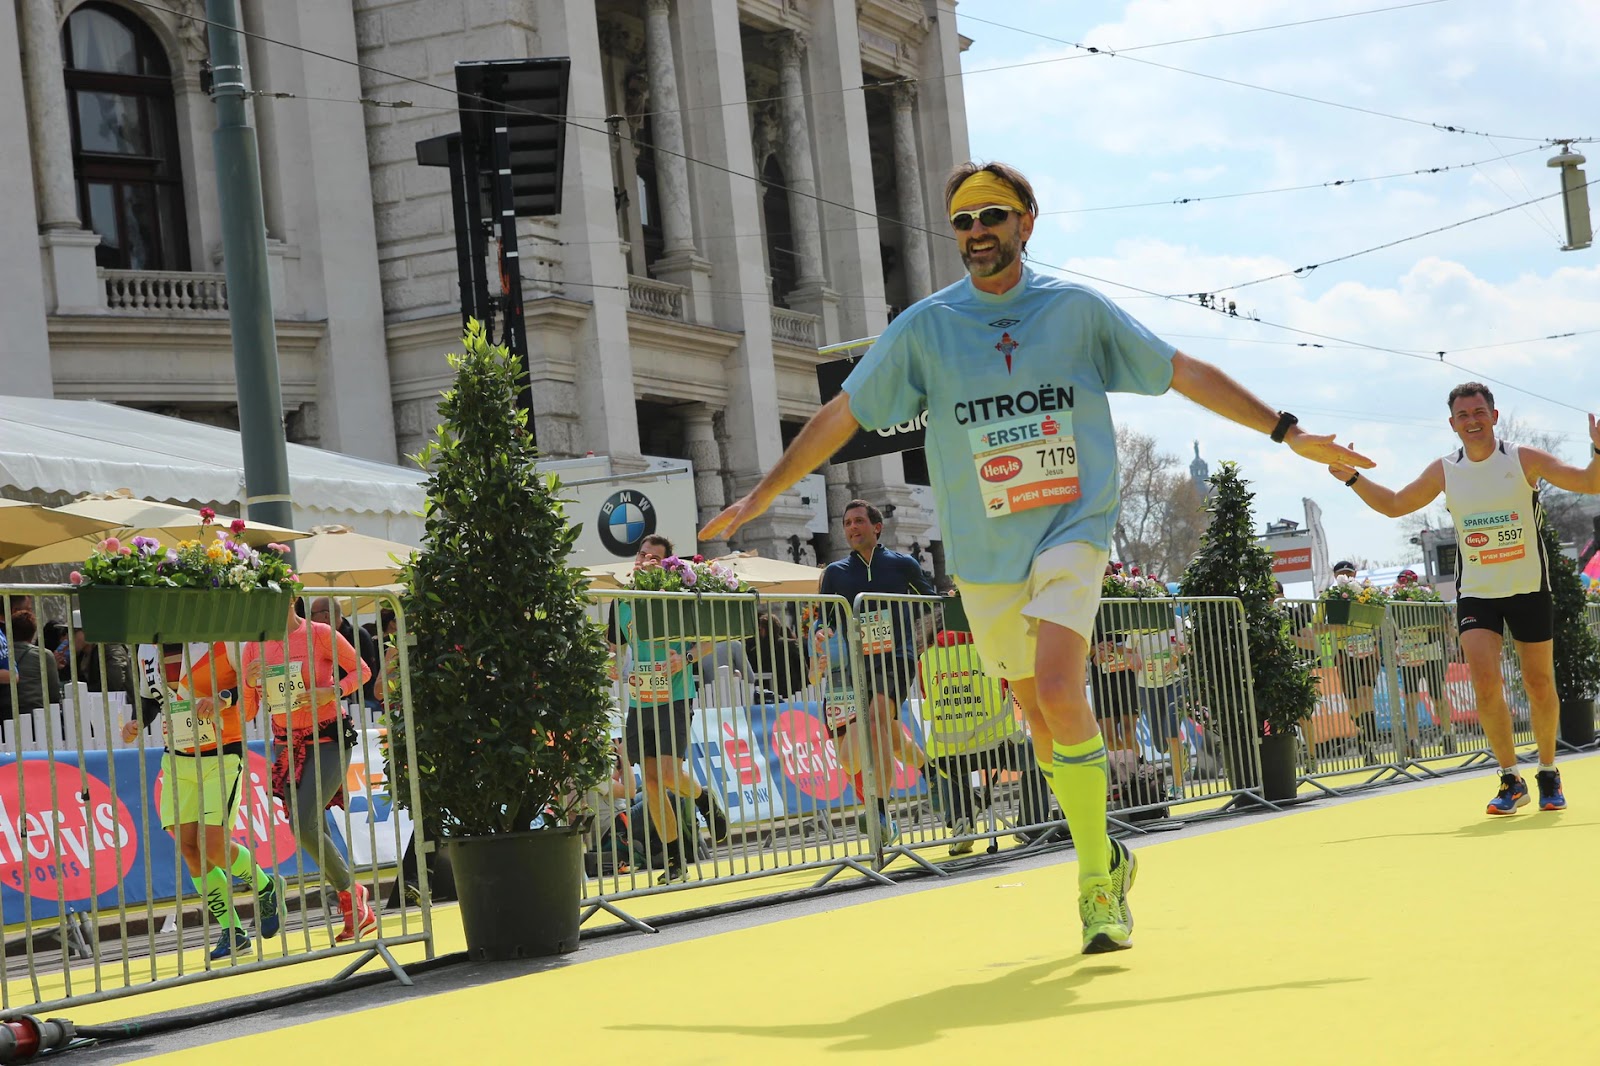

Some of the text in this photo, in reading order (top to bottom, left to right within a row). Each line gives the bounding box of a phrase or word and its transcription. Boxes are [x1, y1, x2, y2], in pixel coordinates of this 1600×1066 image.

[955, 384, 1074, 425] CITROËN
[987, 423, 1039, 447] ERSTE
[1036, 446, 1076, 468] 7179
[984, 461, 1020, 478] Hervis
[1045, 468, 1064, 477] Jesus
[602, 491, 651, 515] BMW
[1012, 490, 1039, 503] WIEN
[1463, 514, 1510, 527] SPARKASSE
[1467, 535, 1488, 544] Hervis
[1497, 528, 1523, 542] 5597
